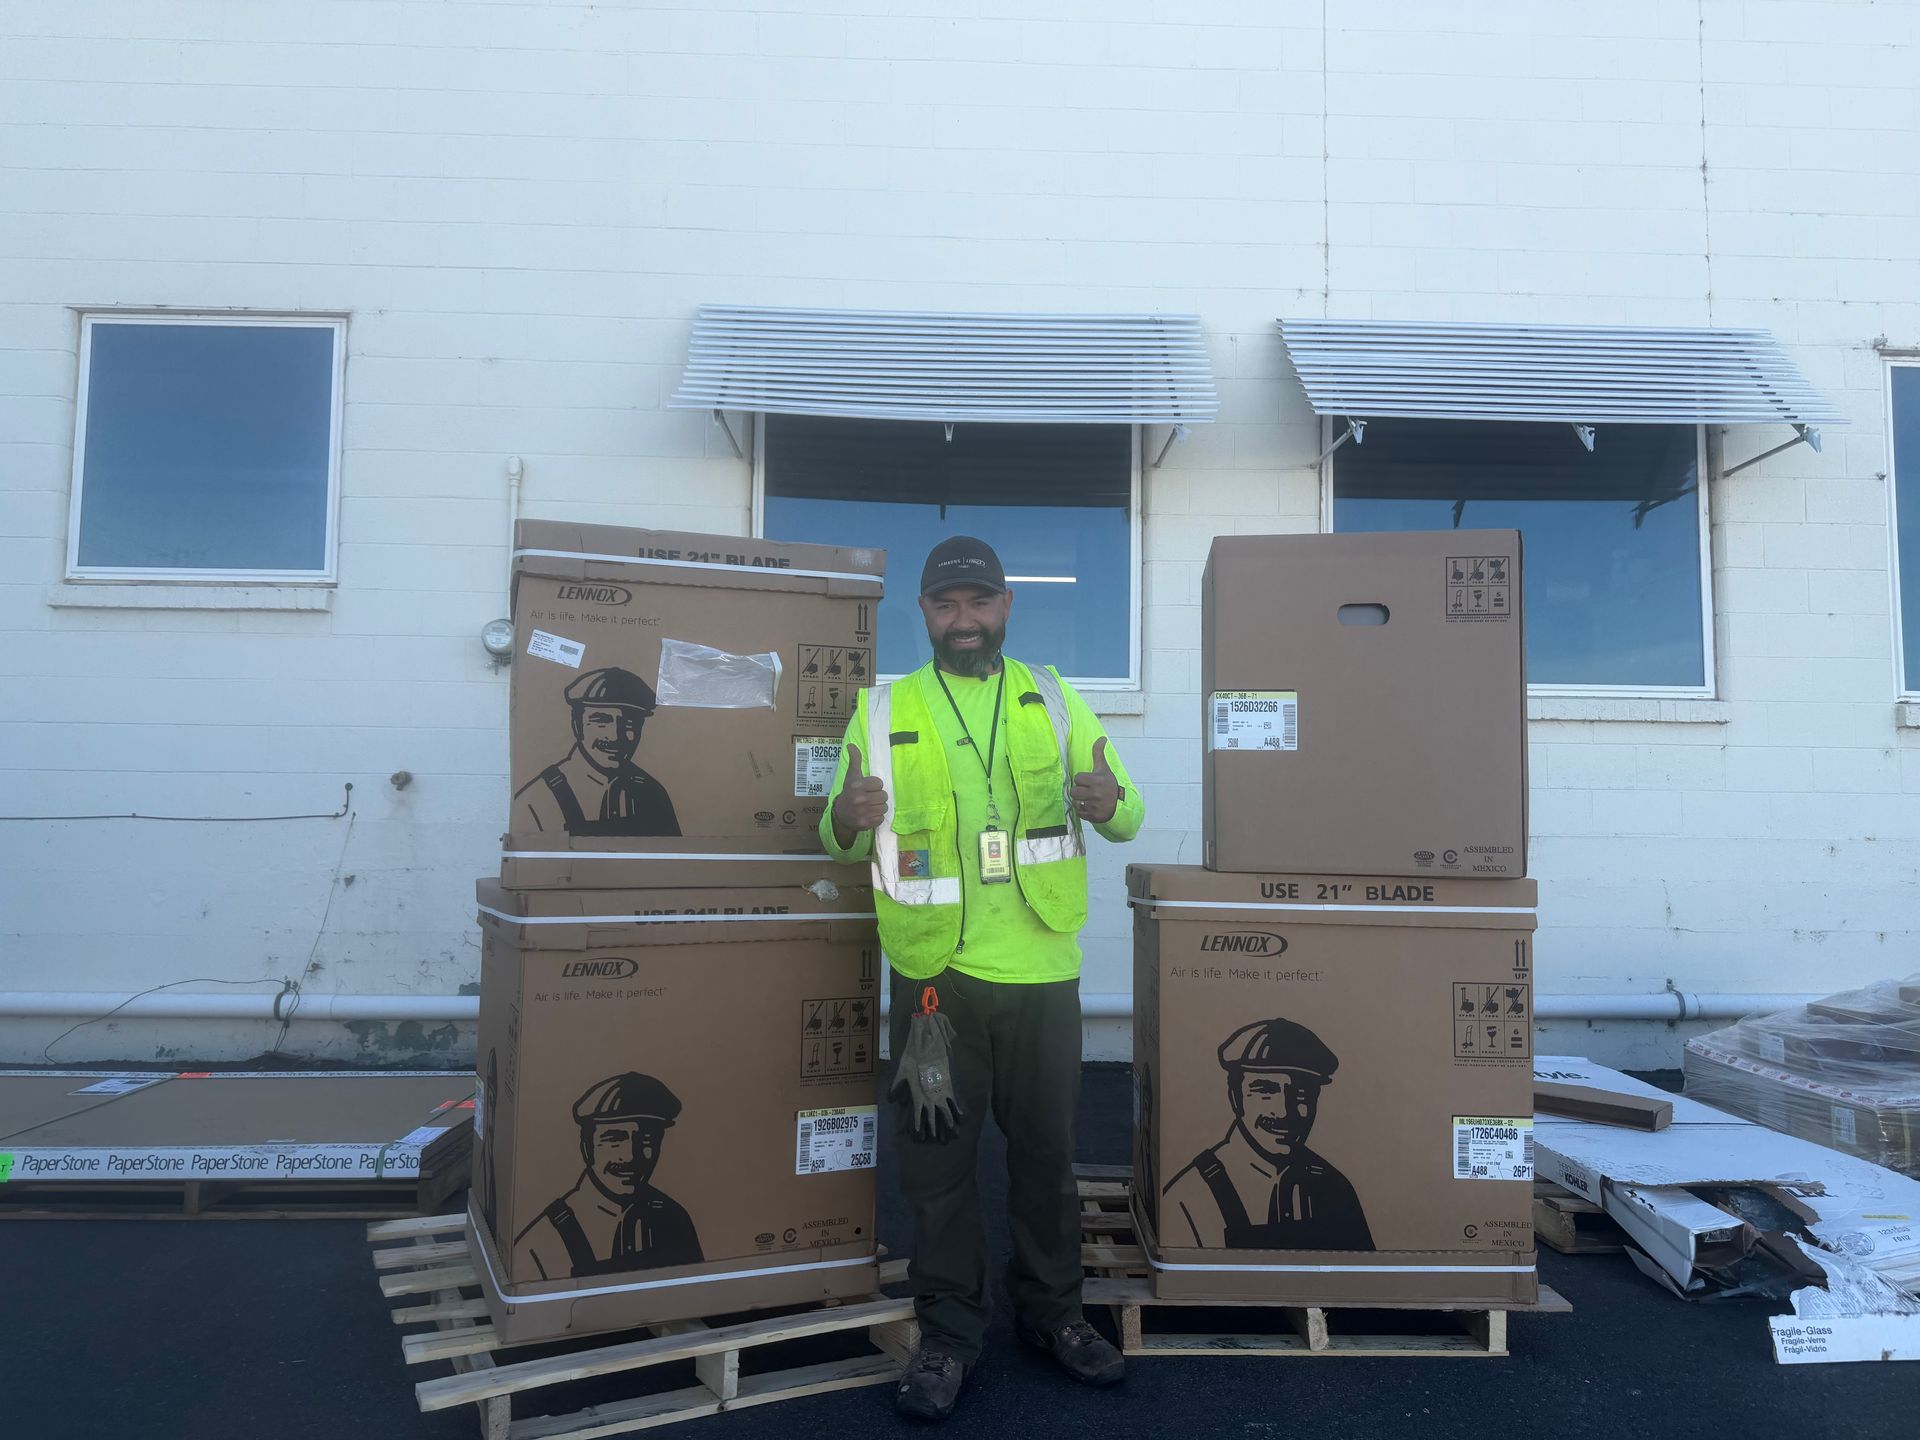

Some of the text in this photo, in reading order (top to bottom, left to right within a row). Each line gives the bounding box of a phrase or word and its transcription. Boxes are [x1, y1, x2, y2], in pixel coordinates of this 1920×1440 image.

[557, 585, 619, 602] LENNOX
[530, 610, 544, 619] Air
[548, 611, 556, 620] is
[581, 613, 608, 623] Make
[611, 615, 617, 624] it
[1230, 701, 1278, 713] 1526D32266
[1463, 846, 1514, 854] ASSEMBLED
[1472, 865, 1507, 873] MEXICO
[1260, 882, 1299, 899] USE
[1365, 885, 1434, 901] BLADE
[1200, 935, 1271, 953] LENNOX
[562, 960, 625, 977] LENNOX
[1170, 967, 1186, 977] Air
[1191, 967, 1200, 978] is
[1228, 968, 1260, 980] Make
[1264, 969, 1274, 980] it
[861, 983, 873, 991] UP
[534, 992, 549, 1001] Air
[552, 992, 560, 1001] is
[586, 989, 613, 1000] Make
[616, 988, 623, 998] it
[813, 1116, 859, 1131] 1926B02975
[1470, 1127, 1518, 1141] 1726C40486
[21, 1154, 100, 1175] PaperStone
[107, 1154, 185, 1175] PaperStone
[191, 1154, 268, 1175] PaperStone
[275, 1154, 353, 1174] PaperStone
[802, 1217, 849, 1229] ASSEMBLED
[1483, 1220, 1533, 1229] ASSEMBLED
[821, 1229, 830, 1237] IN
[1503, 1230, 1512, 1238] IN
[809, 1237, 841, 1249] MEXICO
[1491, 1239, 1525, 1248] MEXICO
[1770, 1325, 1833, 1338] Fragile-Glass
[1781, 1336, 1826, 1346] Fragile-Verre
